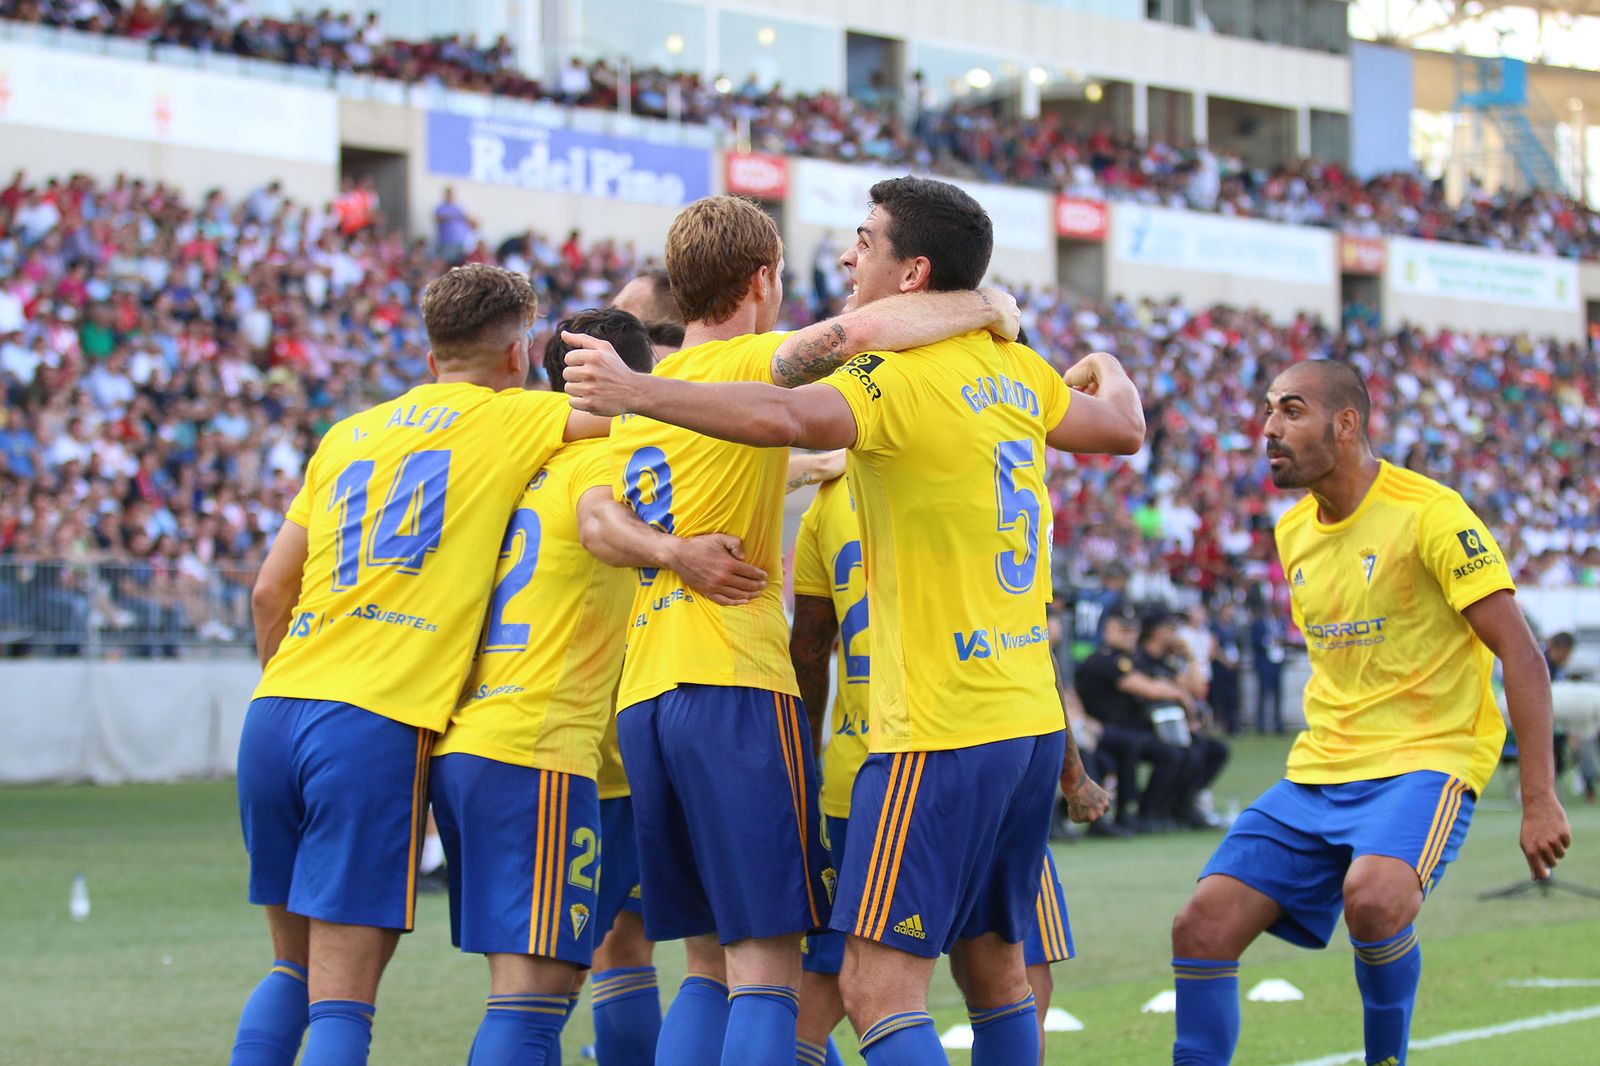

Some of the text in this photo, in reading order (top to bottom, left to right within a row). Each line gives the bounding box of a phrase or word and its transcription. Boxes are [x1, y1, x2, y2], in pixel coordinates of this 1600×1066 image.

[328, 449, 452, 593] 14
[994, 438, 1040, 595] 5
[953, 629, 992, 662] VS
[567, 827, 602, 896] 2
[893, 925, 926, 940] adidas
